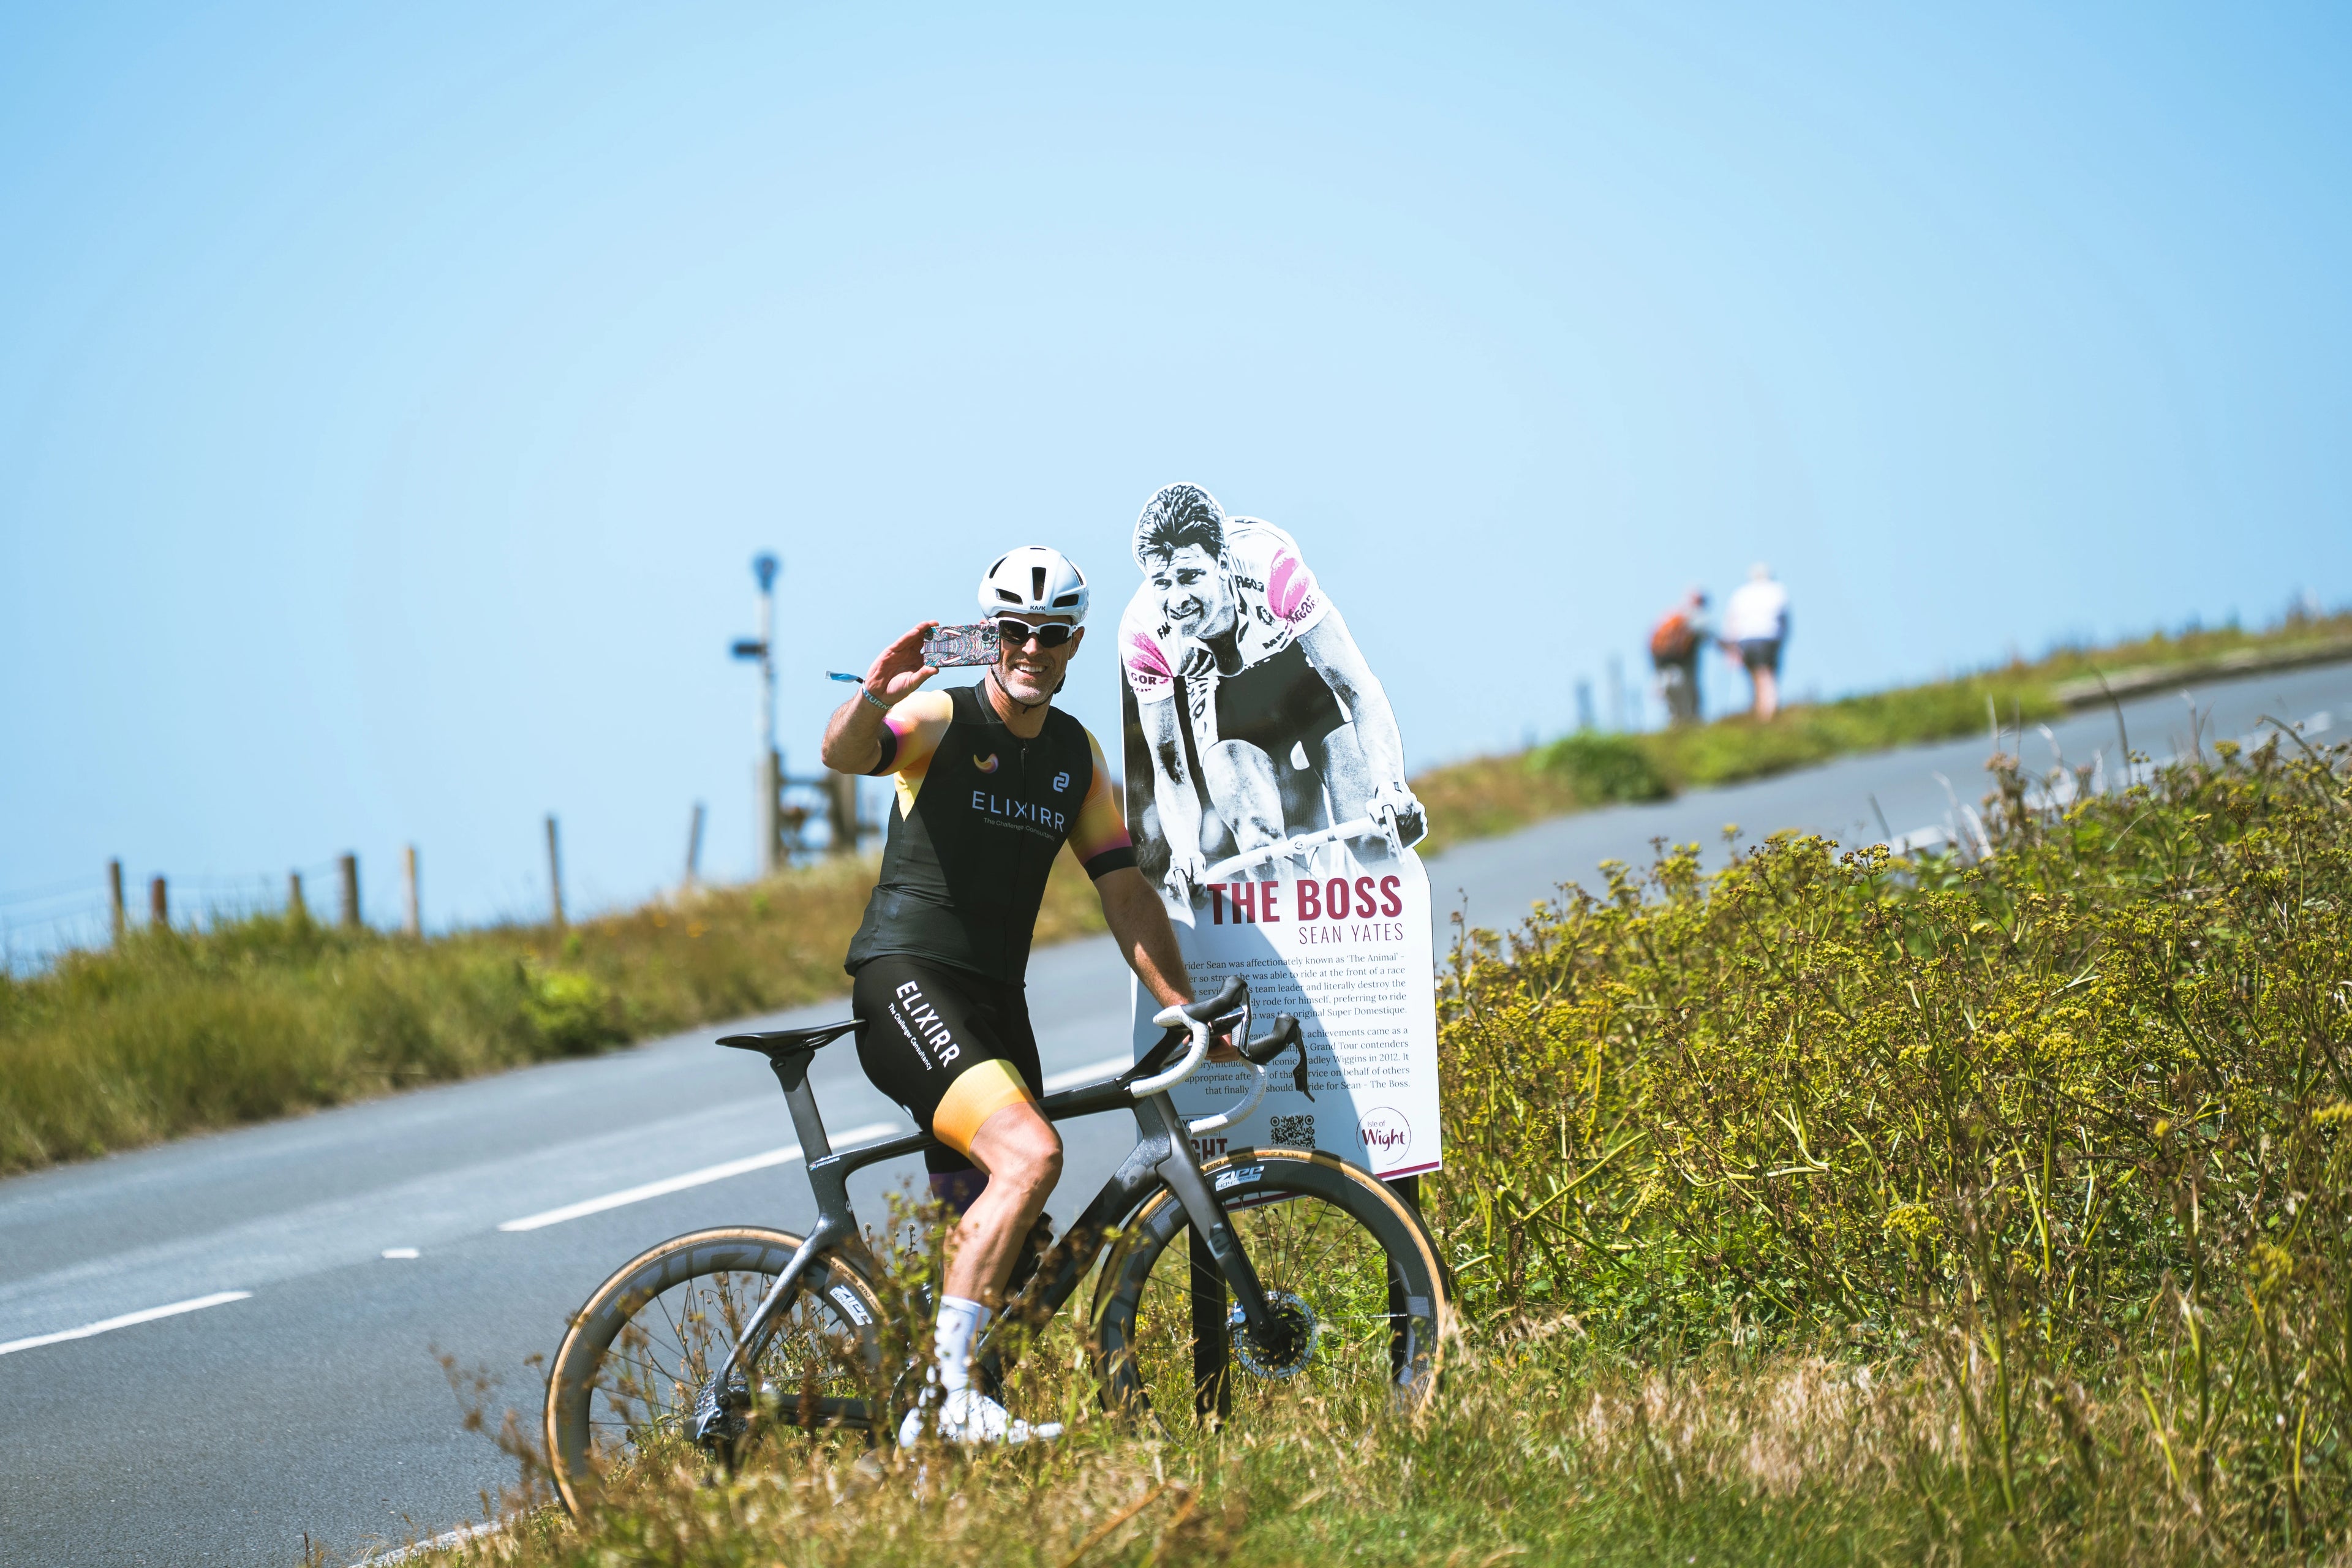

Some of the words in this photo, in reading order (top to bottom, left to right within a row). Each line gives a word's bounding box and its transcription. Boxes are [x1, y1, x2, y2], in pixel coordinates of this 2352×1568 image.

[972, 790, 1065, 832] ELIXIRR
[1026, 825, 1055, 842] Consultancy
[1207, 881, 1280, 925] THE
[1297, 875, 1403, 921] BOSS
[1299, 925, 1341, 944] SEAN
[1351, 923, 1403, 943] YATES
[1207, 960, 1226, 969] Sean
[1246, 957, 1303, 968] affectionately
[1305, 956, 1333, 965] known
[1270, 971, 1287, 979] able
[1301, 970, 1317, 978] ride
[1346, 967, 1367, 976] front
[1369, 967, 1379, 975] of
[1278, 984, 1304, 992] leader
[1306, 982, 1322, 991] and
[1324, 981, 1355, 992] literally
[1357, 980, 1390, 990] destroy
[1392, 979, 1406, 987] the
[1250, 998, 1261, 1008] ely
[1263, 997, 1282, 1006] rode
[1284, 997, 1296, 1005] for
[1298, 995, 1332, 1005] himself,
[1333, 994, 1377, 1005] preferring
[1390, 992, 1407, 1001] ride
[1293, 1009, 1325, 1020] original
[1327, 1008, 1352, 1018] Super
[1354, 1006, 1407, 1016] Domestique.
[895, 981, 960, 1068] ELIXIRR
[1307, 1029, 1365, 1038] achievements
[894, 1013, 912, 1039] Challenger
[910, 1037, 933, 1071] Consultancy
[1310, 1042, 1336, 1051] Grand
[1338, 1041, 1359, 1050] Tour
[1360, 1040, 1409, 1049] contenders
[1272, 1057, 1297, 1066] iconic
[1307, 1055, 1331, 1066] radley
[1333, 1055, 1367, 1065] Wiggins
[1379, 1053, 1401, 1061] 2012.
[1403, 1052, 1409, 1061] It
[1185, 1074, 1233, 1084] appropriate
[1235, 1072, 1251, 1081] afte
[1269, 1070, 1278, 1079] of
[1280, 1070, 1294, 1079] tha
[1343, 1068, 1370, 1076] behalf
[1371, 1066, 1381, 1075] of
[1382, 1066, 1410, 1075] others
[1205, 1087, 1222, 1095] that
[1224, 1085, 1250, 1096] finally
[1265, 1084, 1293, 1093] should
[1308, 1082, 1326, 1091] ride
[1327, 1081, 1339, 1090] for
[1341, 1081, 1361, 1090] Sean
[1389, 1080, 1411, 1088] Boss.
[1362, 1128, 1406, 1152] Wight
[1207, 1161, 1222, 1170] PRO
[1216, 1166, 1265, 1183] ZIPP
[858, 1284, 871, 1298] PRO
[832, 1284, 873, 1324] ZIPP
